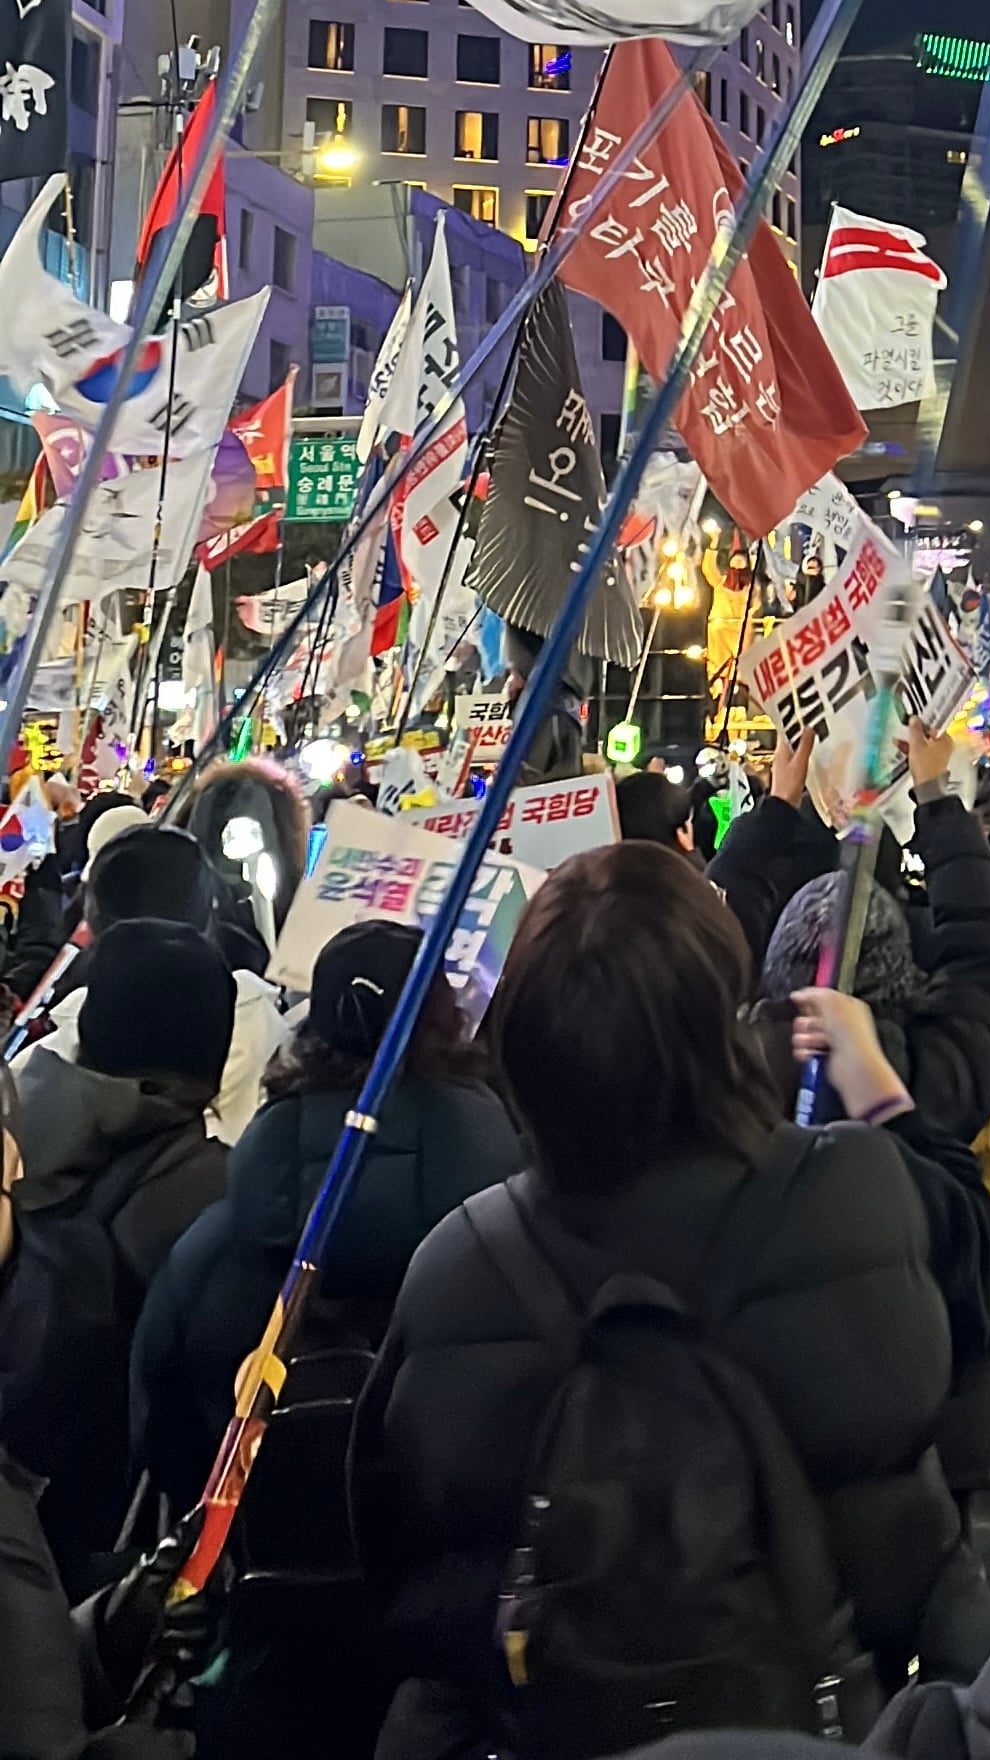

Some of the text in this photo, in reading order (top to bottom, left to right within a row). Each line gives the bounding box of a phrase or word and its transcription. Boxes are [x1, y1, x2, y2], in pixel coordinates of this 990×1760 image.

[299, 444, 356, 463] 서울역
[297, 476, 354, 492] 숭례문
[521, 787, 600, 824] 국힘당
